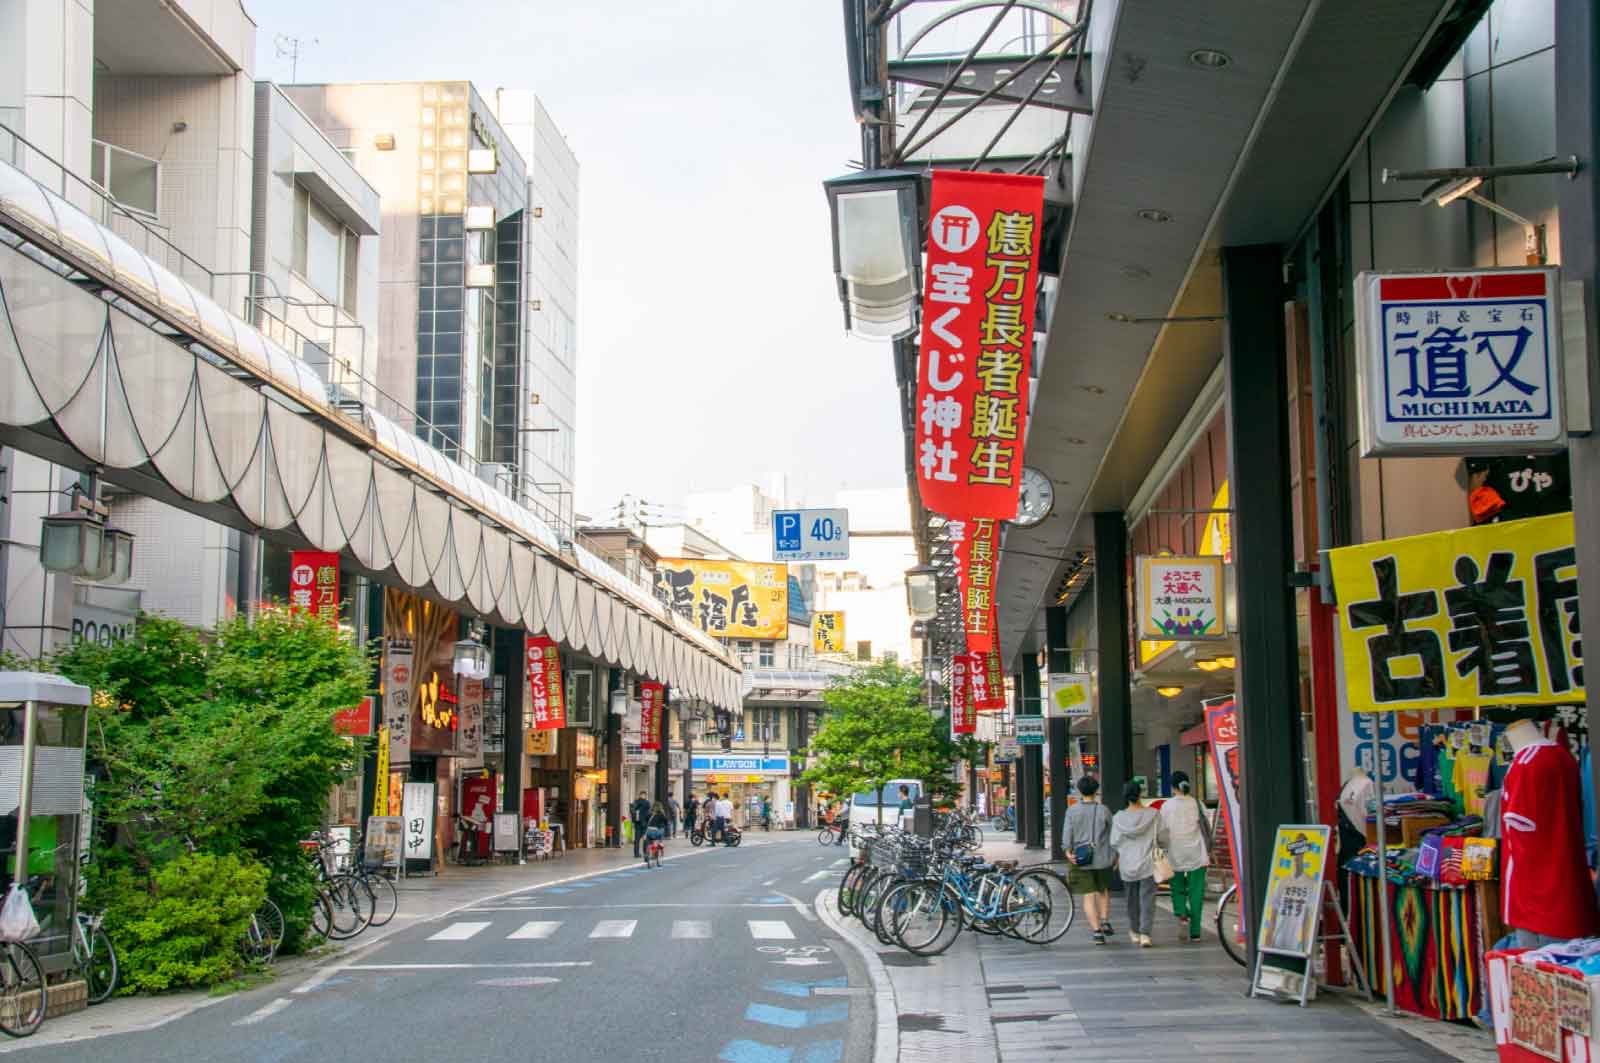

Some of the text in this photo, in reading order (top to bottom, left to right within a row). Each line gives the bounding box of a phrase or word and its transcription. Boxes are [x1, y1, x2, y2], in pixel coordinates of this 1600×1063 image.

[967, 210, 1037, 489] 億万長者誕生
[919, 261, 974, 483] 宝くじ神社
[1393, 325, 1540, 398] 道又
[1401, 400, 1534, 417] MICHIMATA
[783, 516, 796, 537] P
[1161, 570, 1202, 582] ようこそ
[1163, 582, 1203, 594] 大通へ
[716, 759, 757, 769] LAWSON
[408, 817, 425, 855] 田中
